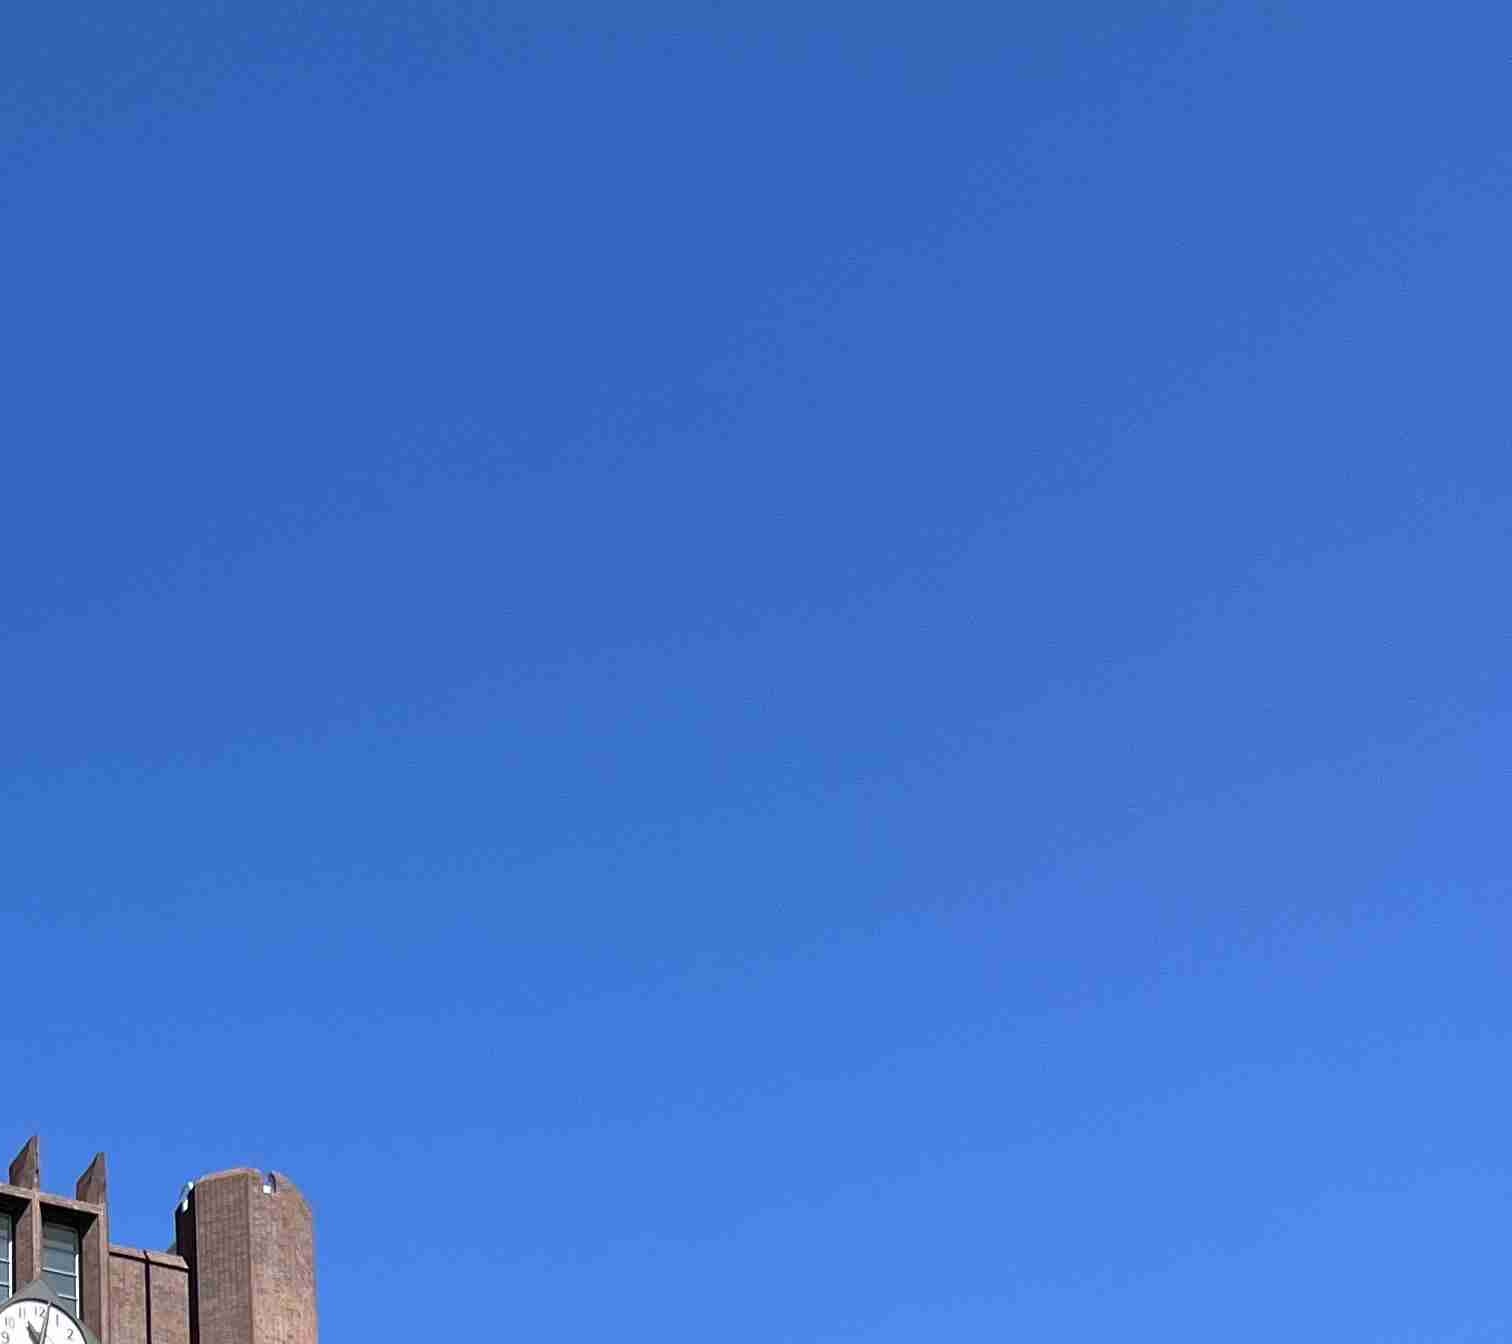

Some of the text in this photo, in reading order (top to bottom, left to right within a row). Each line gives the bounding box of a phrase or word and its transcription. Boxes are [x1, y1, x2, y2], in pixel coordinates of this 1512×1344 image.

[18, 1306, 26, 1319] 11
[34, 1306, 46, 1318] 12
[5, 1316, 15, 1329] 10
[1, 1331, 9, 1344] 9
[66, 1327, 75, 1341] 2
